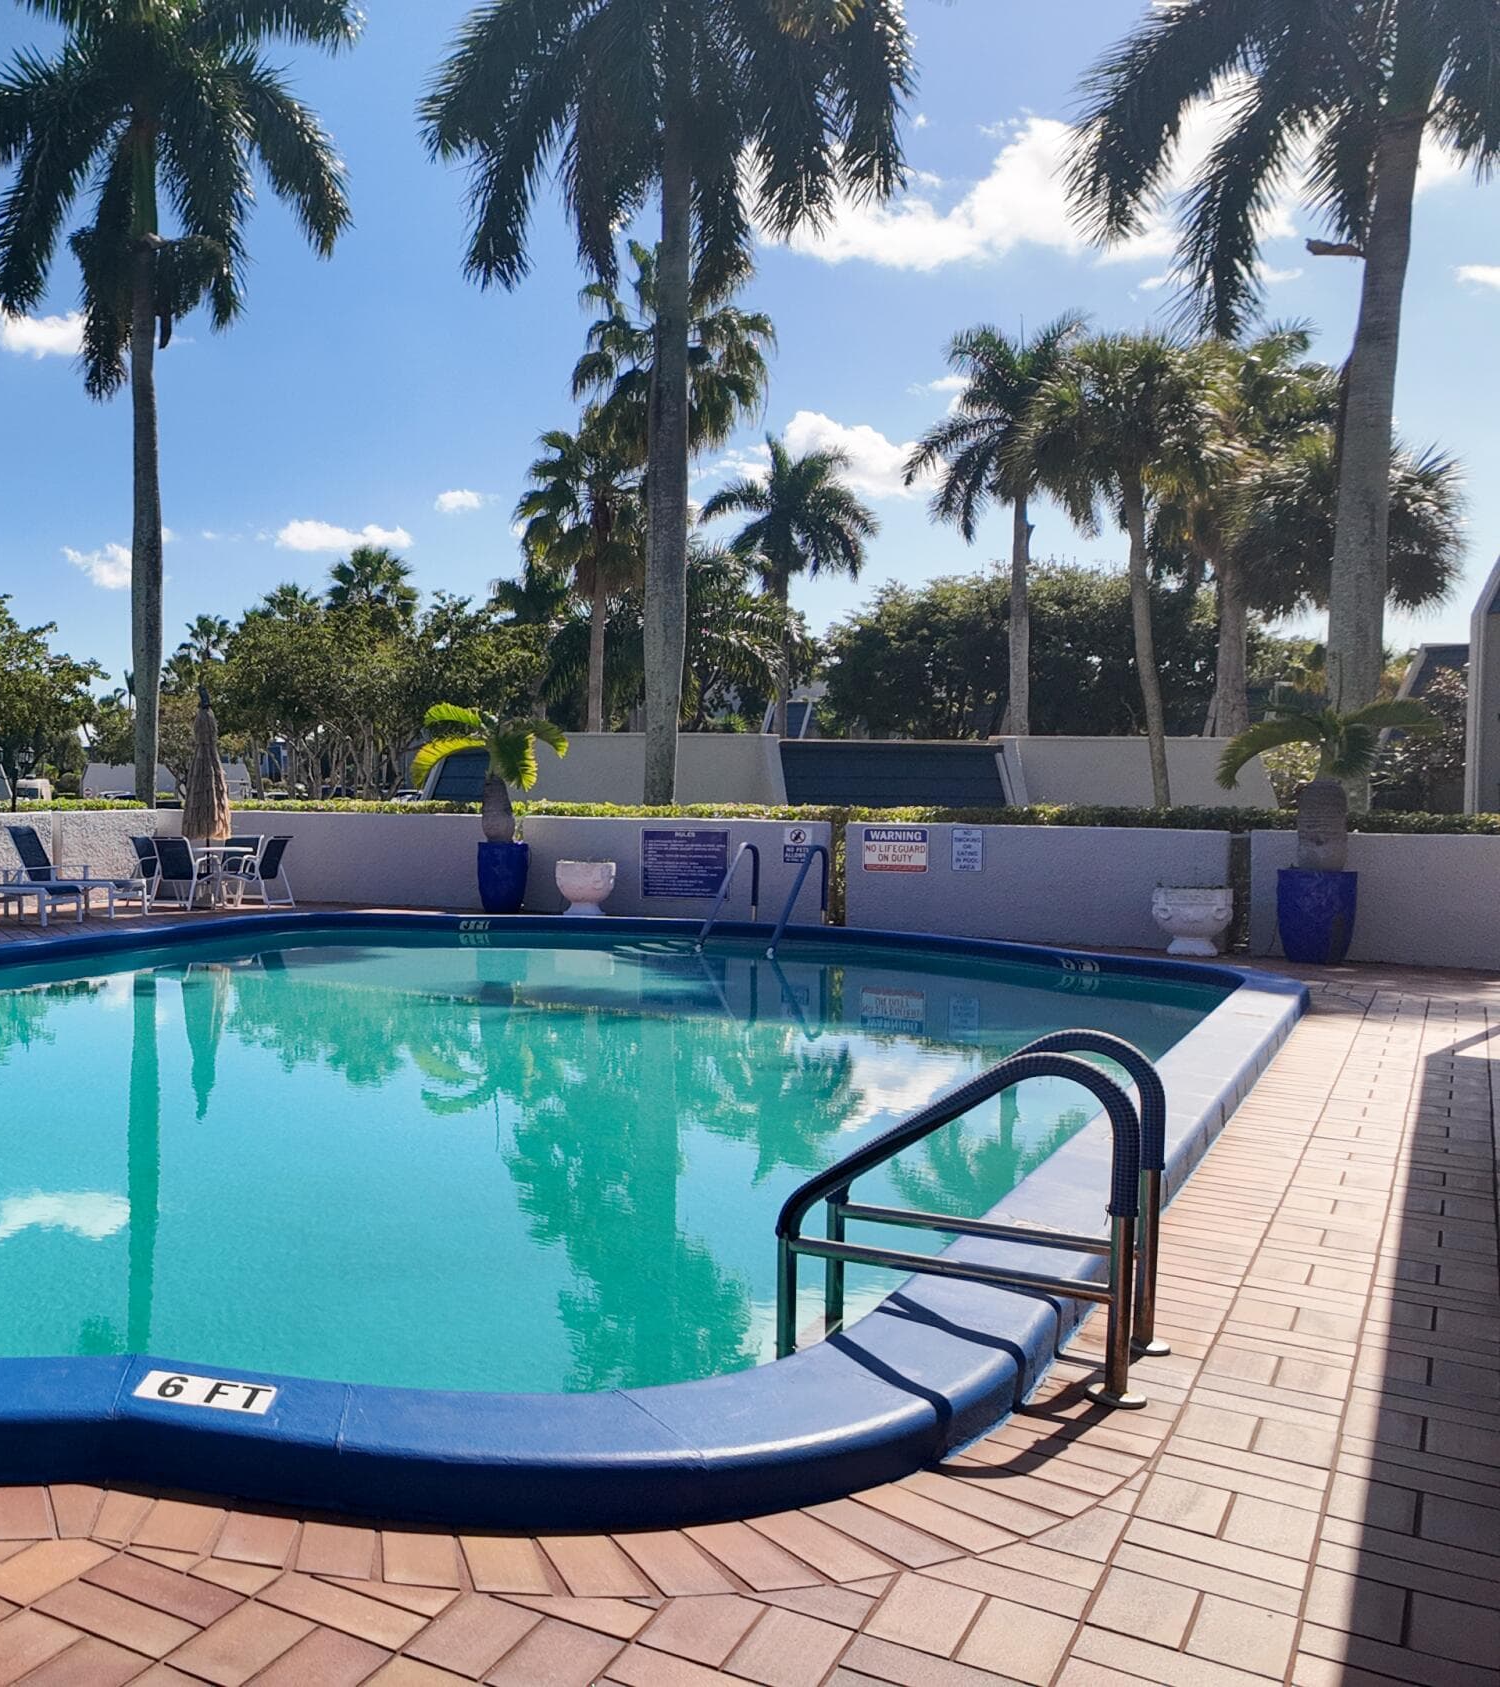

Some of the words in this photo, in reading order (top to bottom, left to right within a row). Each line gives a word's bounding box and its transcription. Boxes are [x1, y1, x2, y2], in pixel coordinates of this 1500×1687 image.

[870, 830, 922, 841] WARNING
[865, 843, 877, 853] NO
[879, 844, 926, 854] LIFEGUARD
[877, 853, 889, 862] ON
[891, 854, 913, 863] DUTY
[157, 1376, 189, 1398] 6
[203, 1382, 272, 1410] FT
